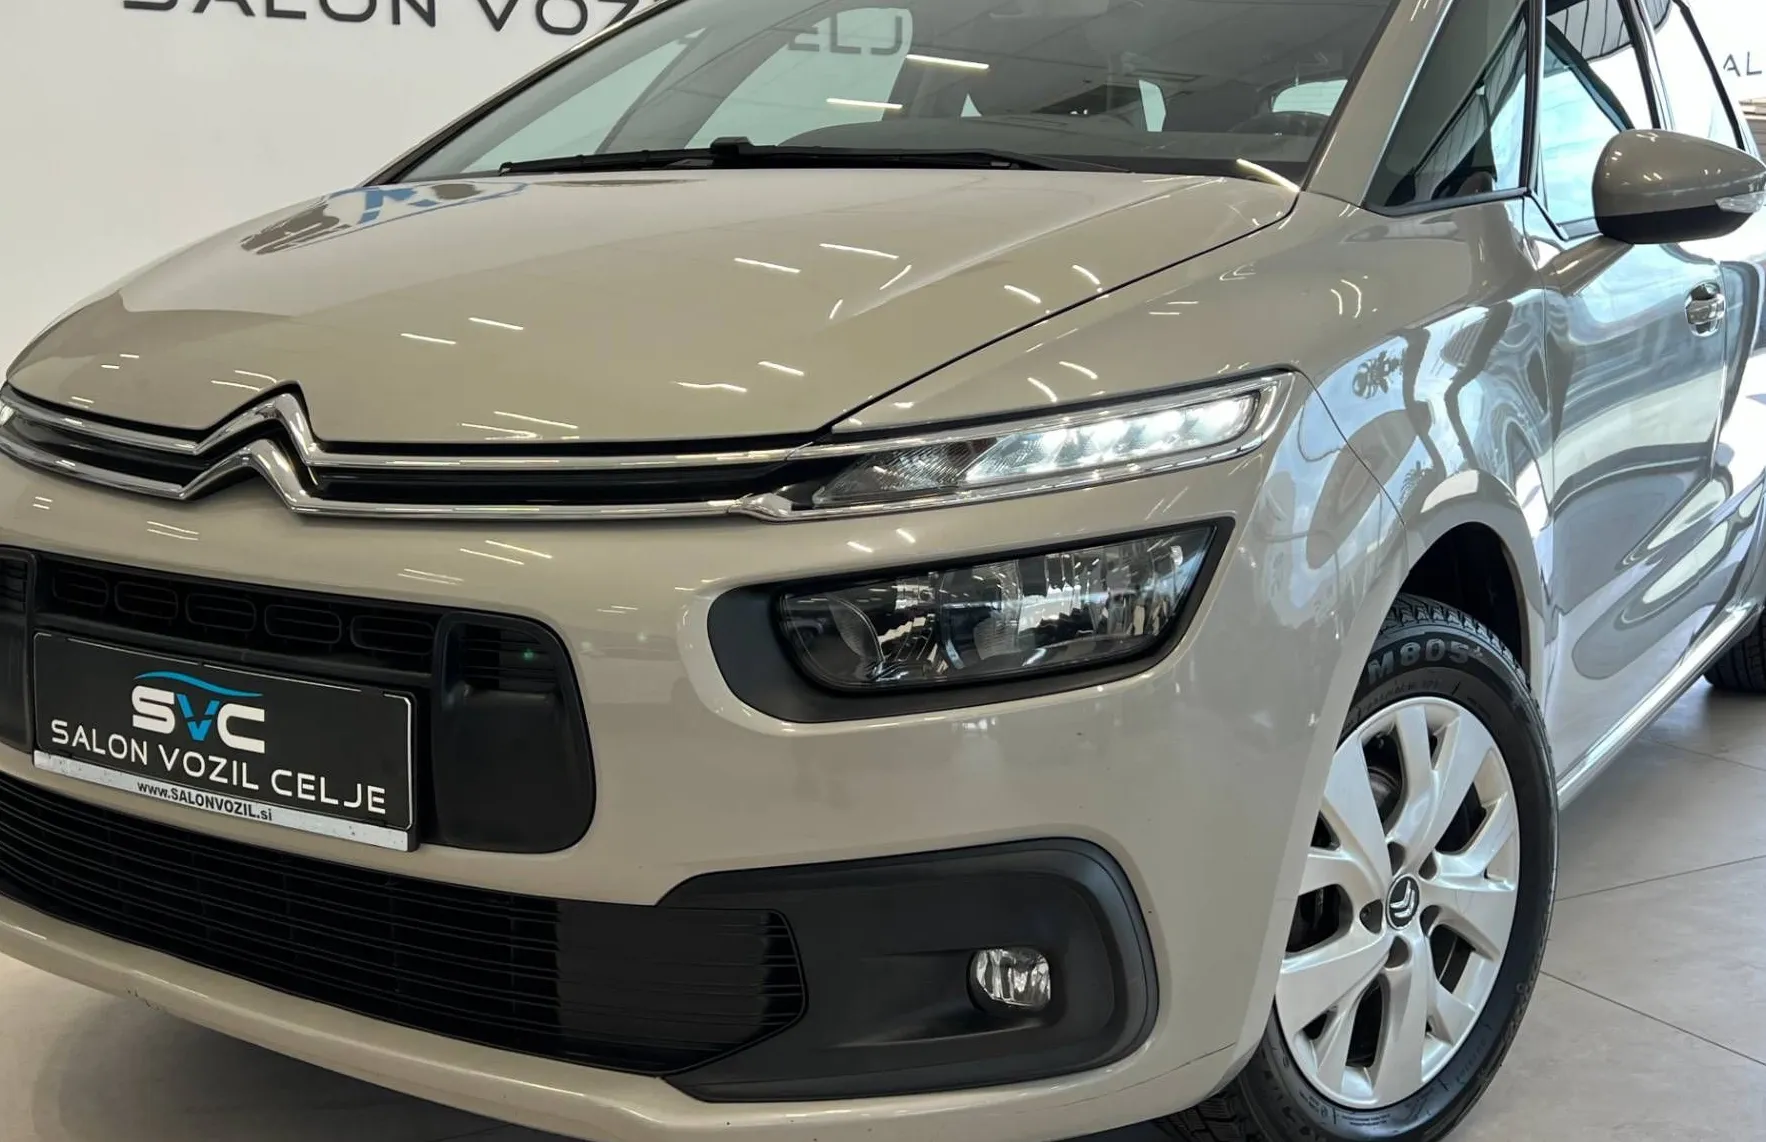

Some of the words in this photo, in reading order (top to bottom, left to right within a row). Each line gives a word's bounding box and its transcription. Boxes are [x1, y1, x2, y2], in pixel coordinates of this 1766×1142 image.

[124, 0, 436, 27] LON
[132, 686, 265, 754] SVC
[51, 719, 148, 765] SALON
[158, 744, 259, 790] VOZIL
[271, 769, 386, 814] CELJE
[137, 780, 273, 821] www.SALONVOZIL.si
